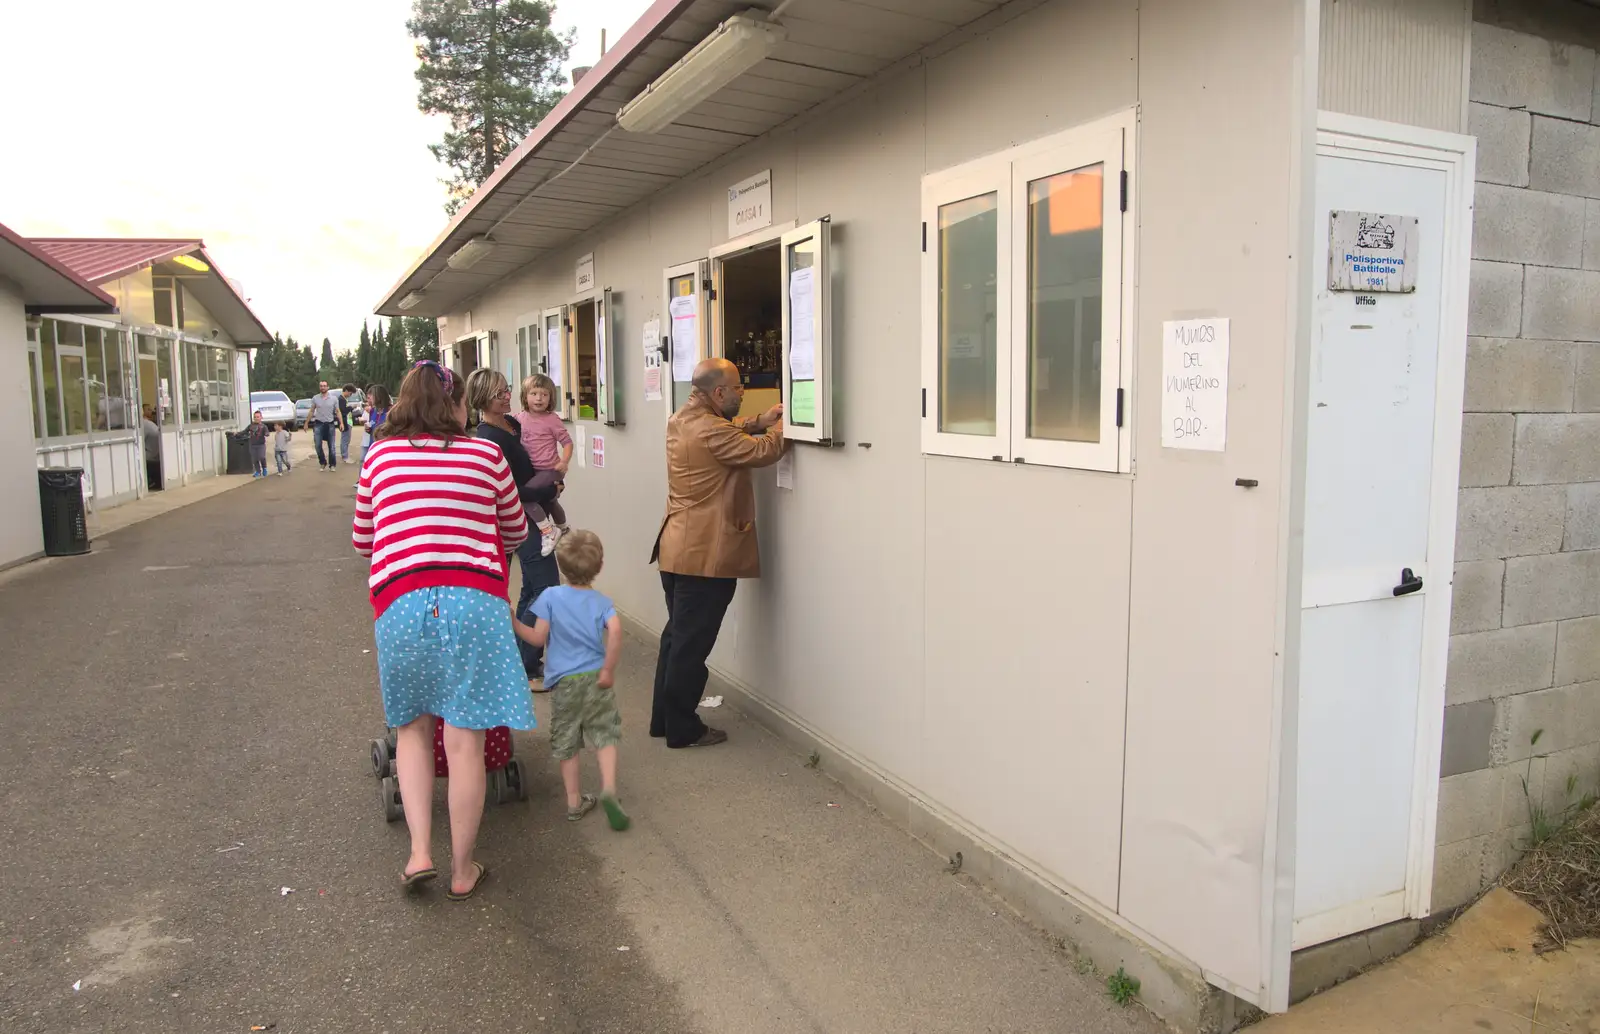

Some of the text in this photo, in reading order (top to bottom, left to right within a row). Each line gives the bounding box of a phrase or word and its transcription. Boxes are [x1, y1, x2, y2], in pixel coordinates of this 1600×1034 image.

[1345, 254, 1405, 266] Polisportiva
[1353, 264, 1396, 274] Battifolle
[1366, 277, 1384, 286] 1981
[1355, 295, 1377, 306] Ufficio
[1183, 352, 1203, 368] DEL
[1166, 374, 1220, 393] NUMERINO
[1185, 396, 1197, 412] AL
